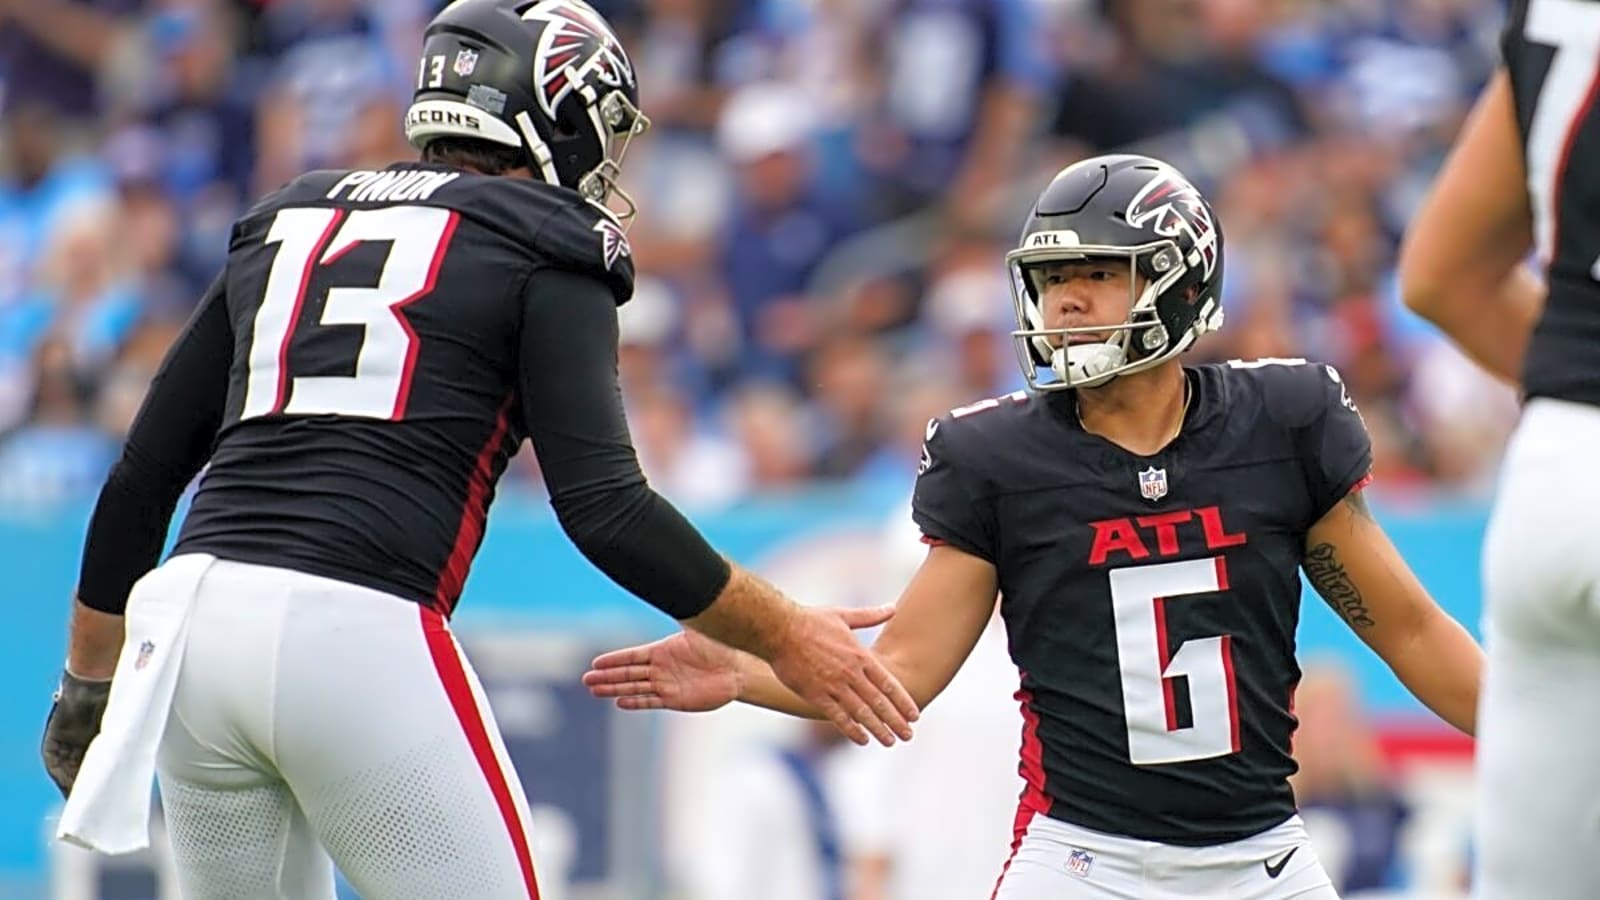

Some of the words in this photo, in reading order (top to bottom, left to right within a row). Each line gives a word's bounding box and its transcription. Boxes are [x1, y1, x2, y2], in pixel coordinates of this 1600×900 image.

[418, 55, 447, 90] 13
[406, 109, 481, 129] LCONS
[326, 170, 460, 202] PINION
[1033, 234, 1061, 246] ATL
[240, 206, 461, 421] 13
[1088, 506, 1247, 564] ATL
[1109, 555, 1241, 764] 6
